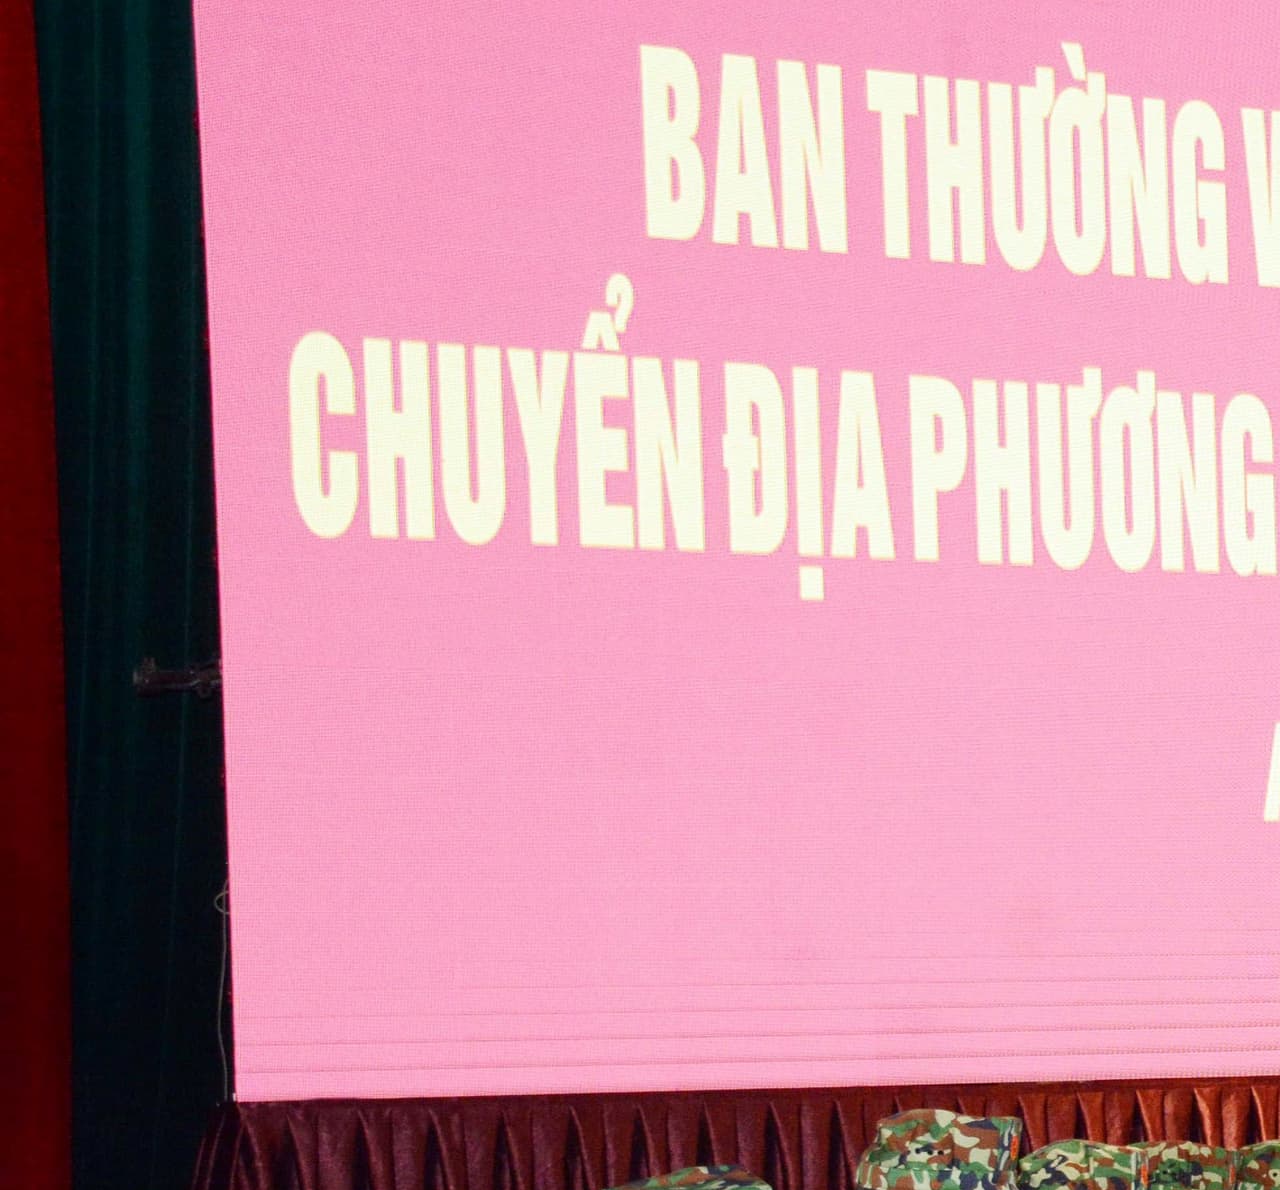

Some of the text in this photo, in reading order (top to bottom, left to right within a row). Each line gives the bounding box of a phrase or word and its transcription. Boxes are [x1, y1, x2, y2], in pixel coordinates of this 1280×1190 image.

[638, 43, 850, 255] BAN
[864, 40, 1230, 286] THƯỜNG
[287, 272, 707, 554] CHUYỂN
[720, 360, 897, 602] ĐỊA
[907, 364, 1279, 578] PHƯƠNG
